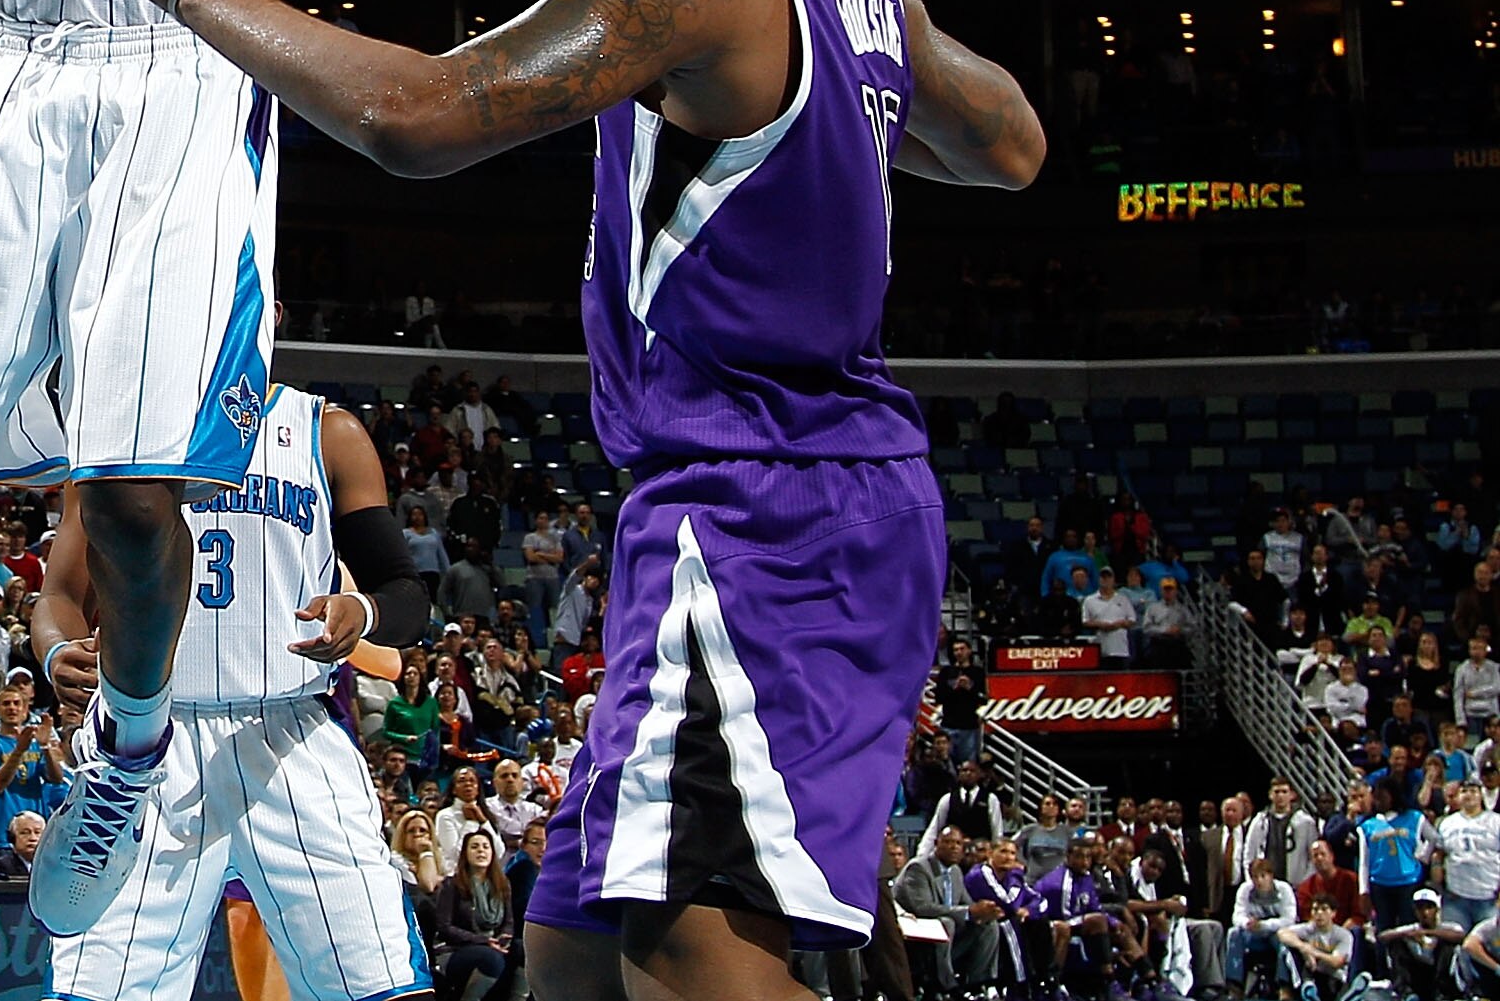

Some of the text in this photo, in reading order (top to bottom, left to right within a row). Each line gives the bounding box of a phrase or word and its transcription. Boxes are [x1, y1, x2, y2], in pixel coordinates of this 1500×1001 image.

[196, 529, 235, 609] 3
[1008, 647, 1084, 660] EMERGENCY
[1032, 659, 1060, 670] EXIT
[980, 685, 1172, 721] udweiser
